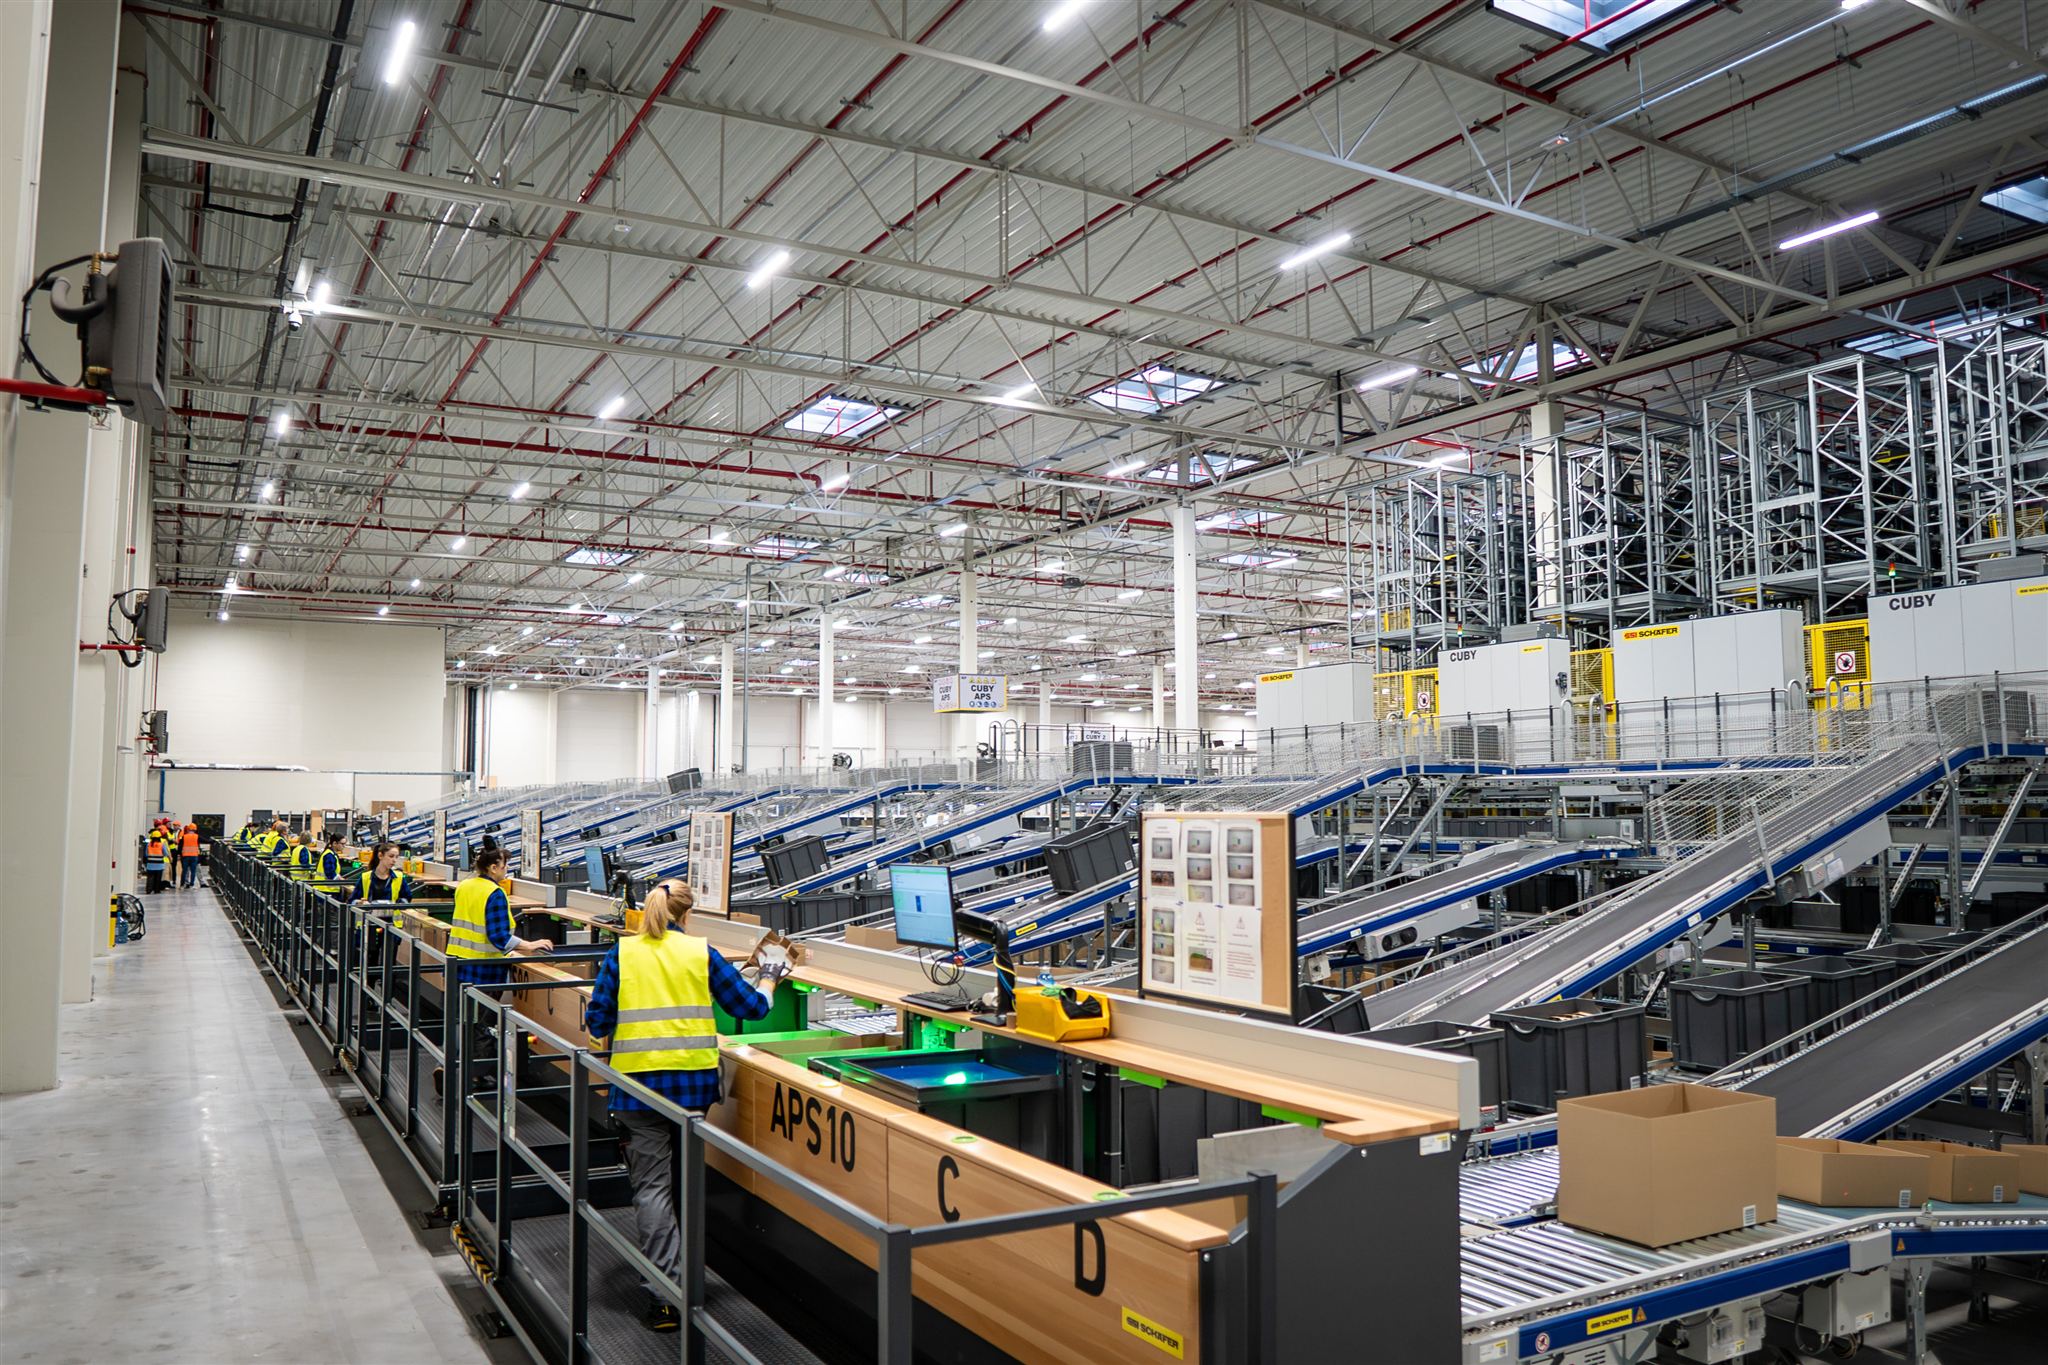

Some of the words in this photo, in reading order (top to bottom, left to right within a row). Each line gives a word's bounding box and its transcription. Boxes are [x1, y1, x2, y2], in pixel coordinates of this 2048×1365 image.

[1889, 593, 1936, 611] CUBY
[1450, 650, 1476, 662] CUBY
[939, 686, 952, 694] CUBY
[971, 684, 994, 692] CUBY
[937, 1155, 961, 1223] C
[1074, 1219, 1106, 1297] D
